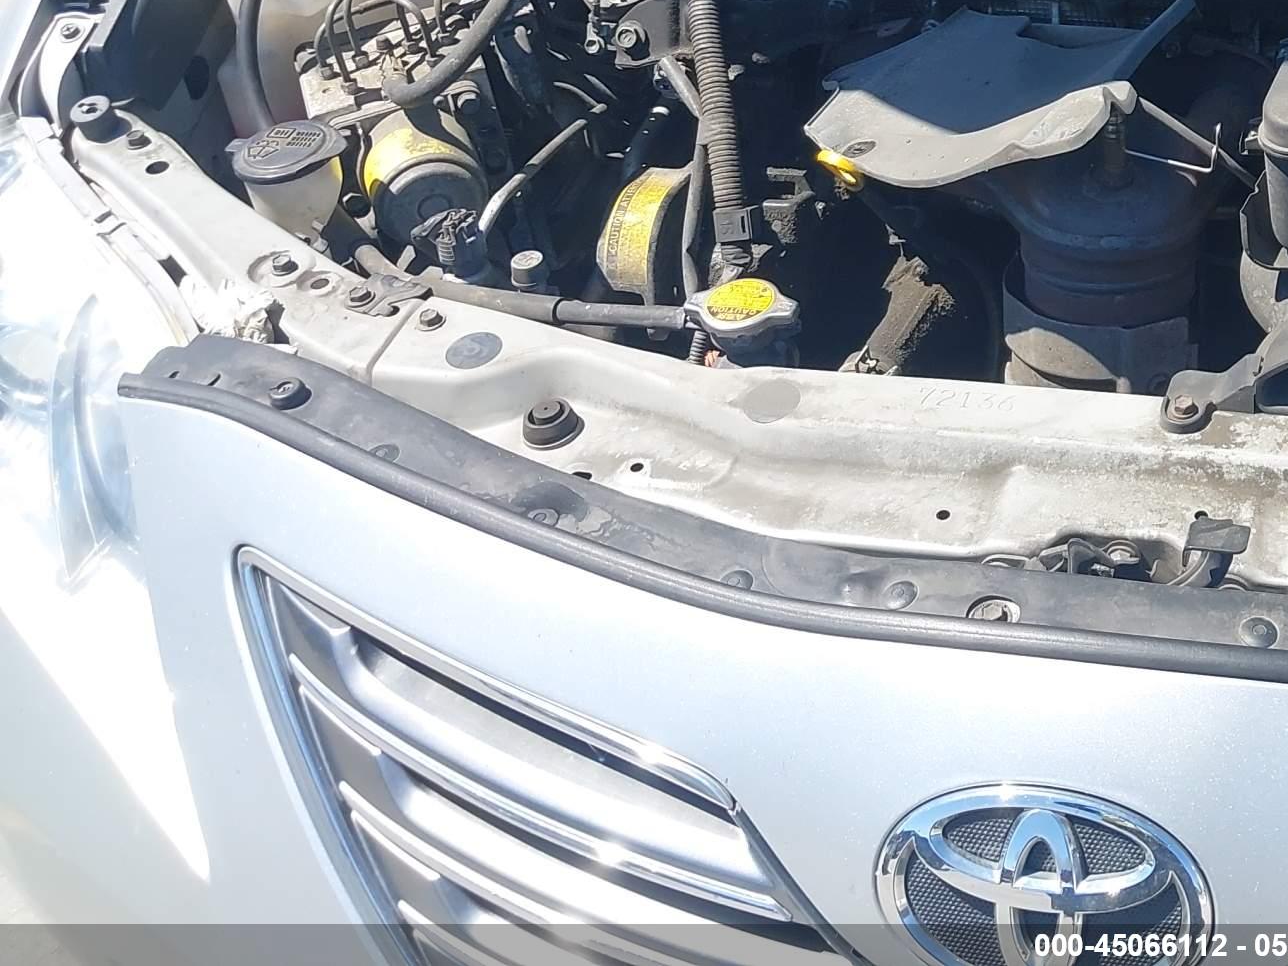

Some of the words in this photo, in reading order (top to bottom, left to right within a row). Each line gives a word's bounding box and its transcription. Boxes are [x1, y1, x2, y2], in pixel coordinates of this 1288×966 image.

[608, 210, 626, 253] CAUTION
[709, 306, 758, 316] CAUTION
[919, 385, 1018, 412] 72136
